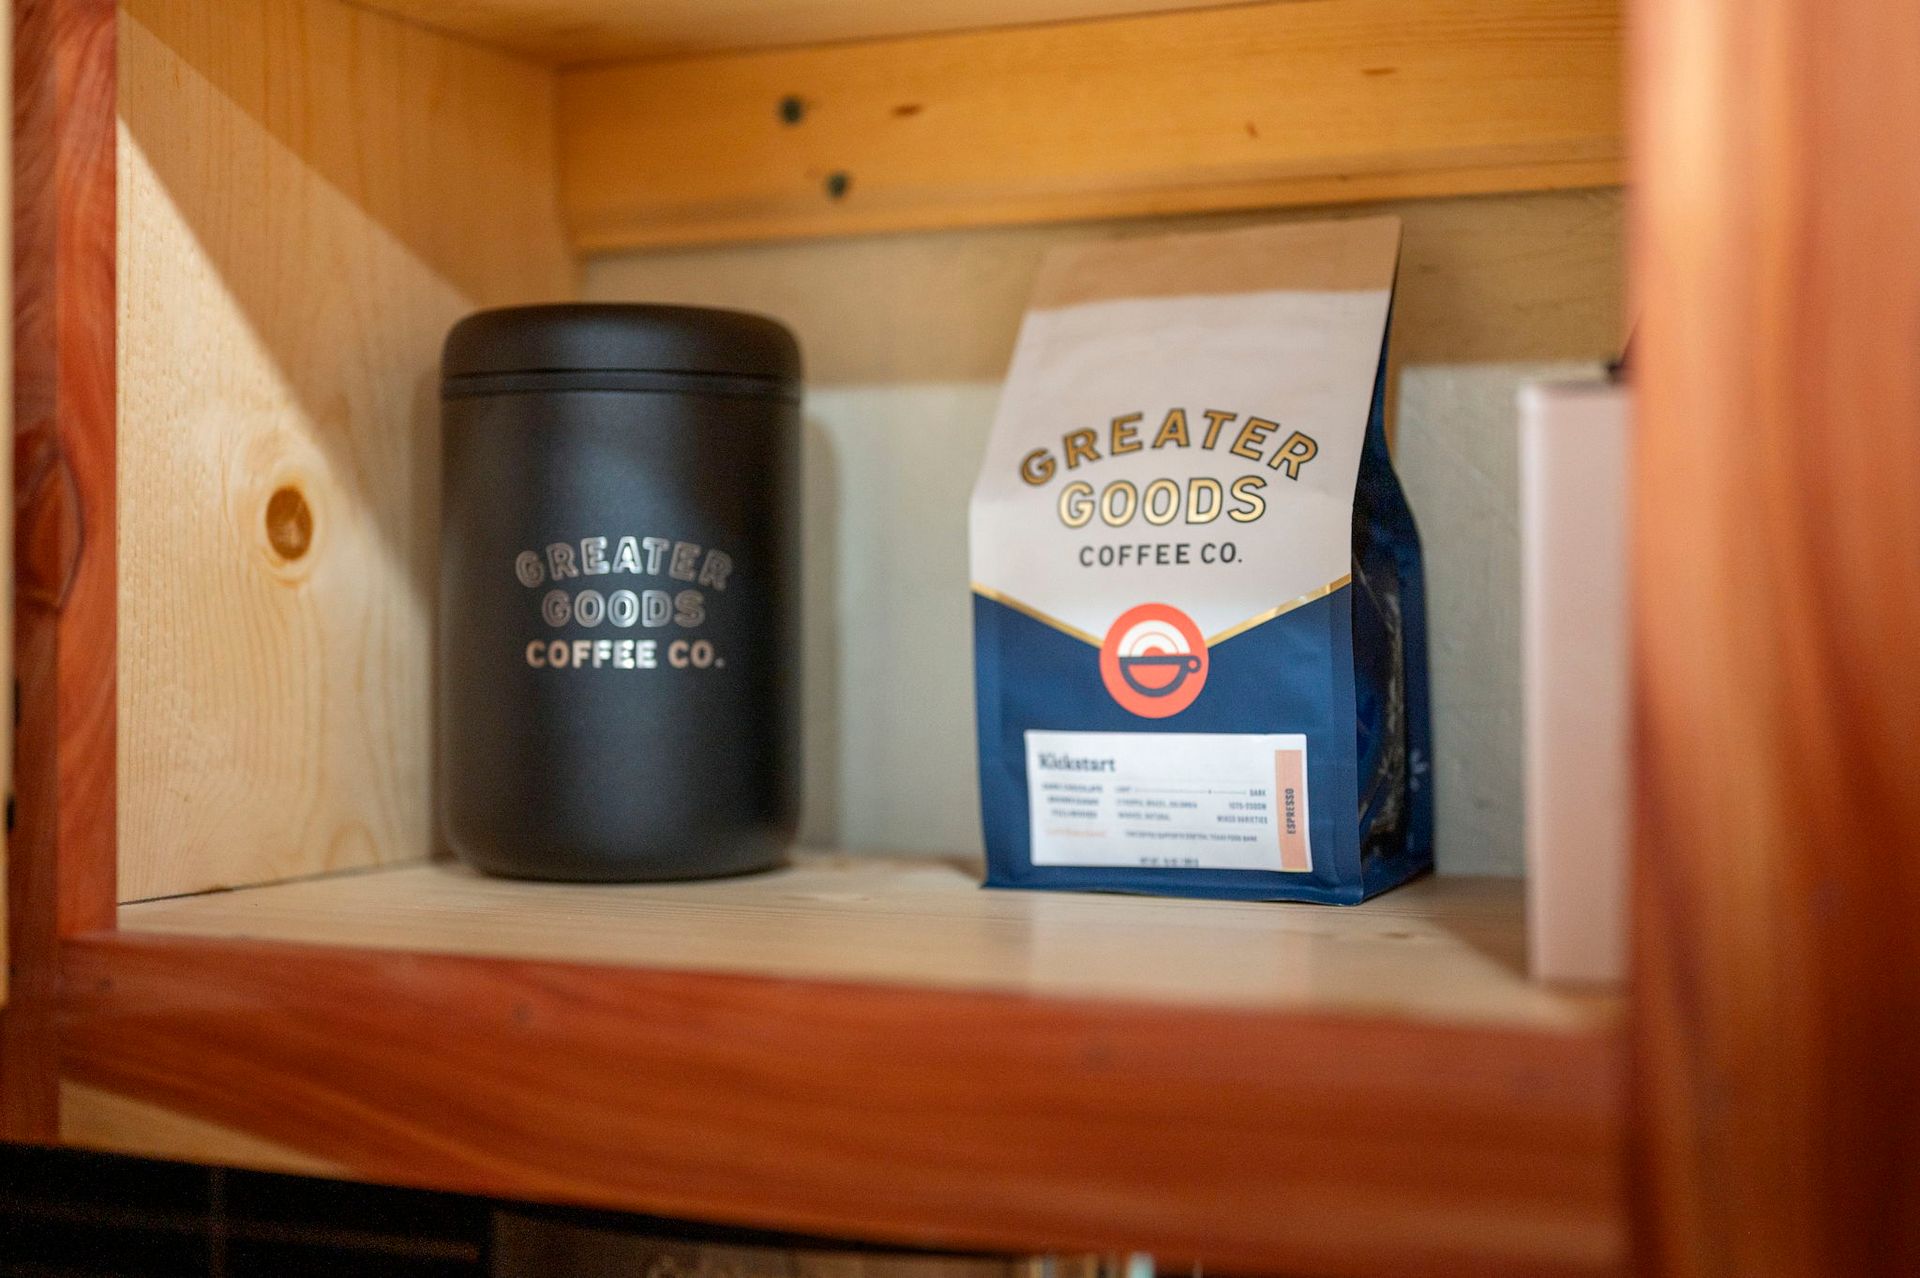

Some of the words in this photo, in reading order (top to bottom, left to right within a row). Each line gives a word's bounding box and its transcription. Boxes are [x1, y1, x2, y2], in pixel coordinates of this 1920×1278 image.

[1019, 408, 1319, 485] GREATER
[1057, 475, 1268, 529] GOODS
[515, 536, 733, 591] GREATER
[1079, 543, 1191, 567] COFFEE
[1200, 541, 1243, 564] CO.
[542, 589, 706, 628] GOODS
[526, 640, 657, 669] COFFEE
[668, 640, 725, 669] CO.
[1038, 752, 1116, 773] Kickstart
[1285, 787, 1297, 835] ESPRESSO
